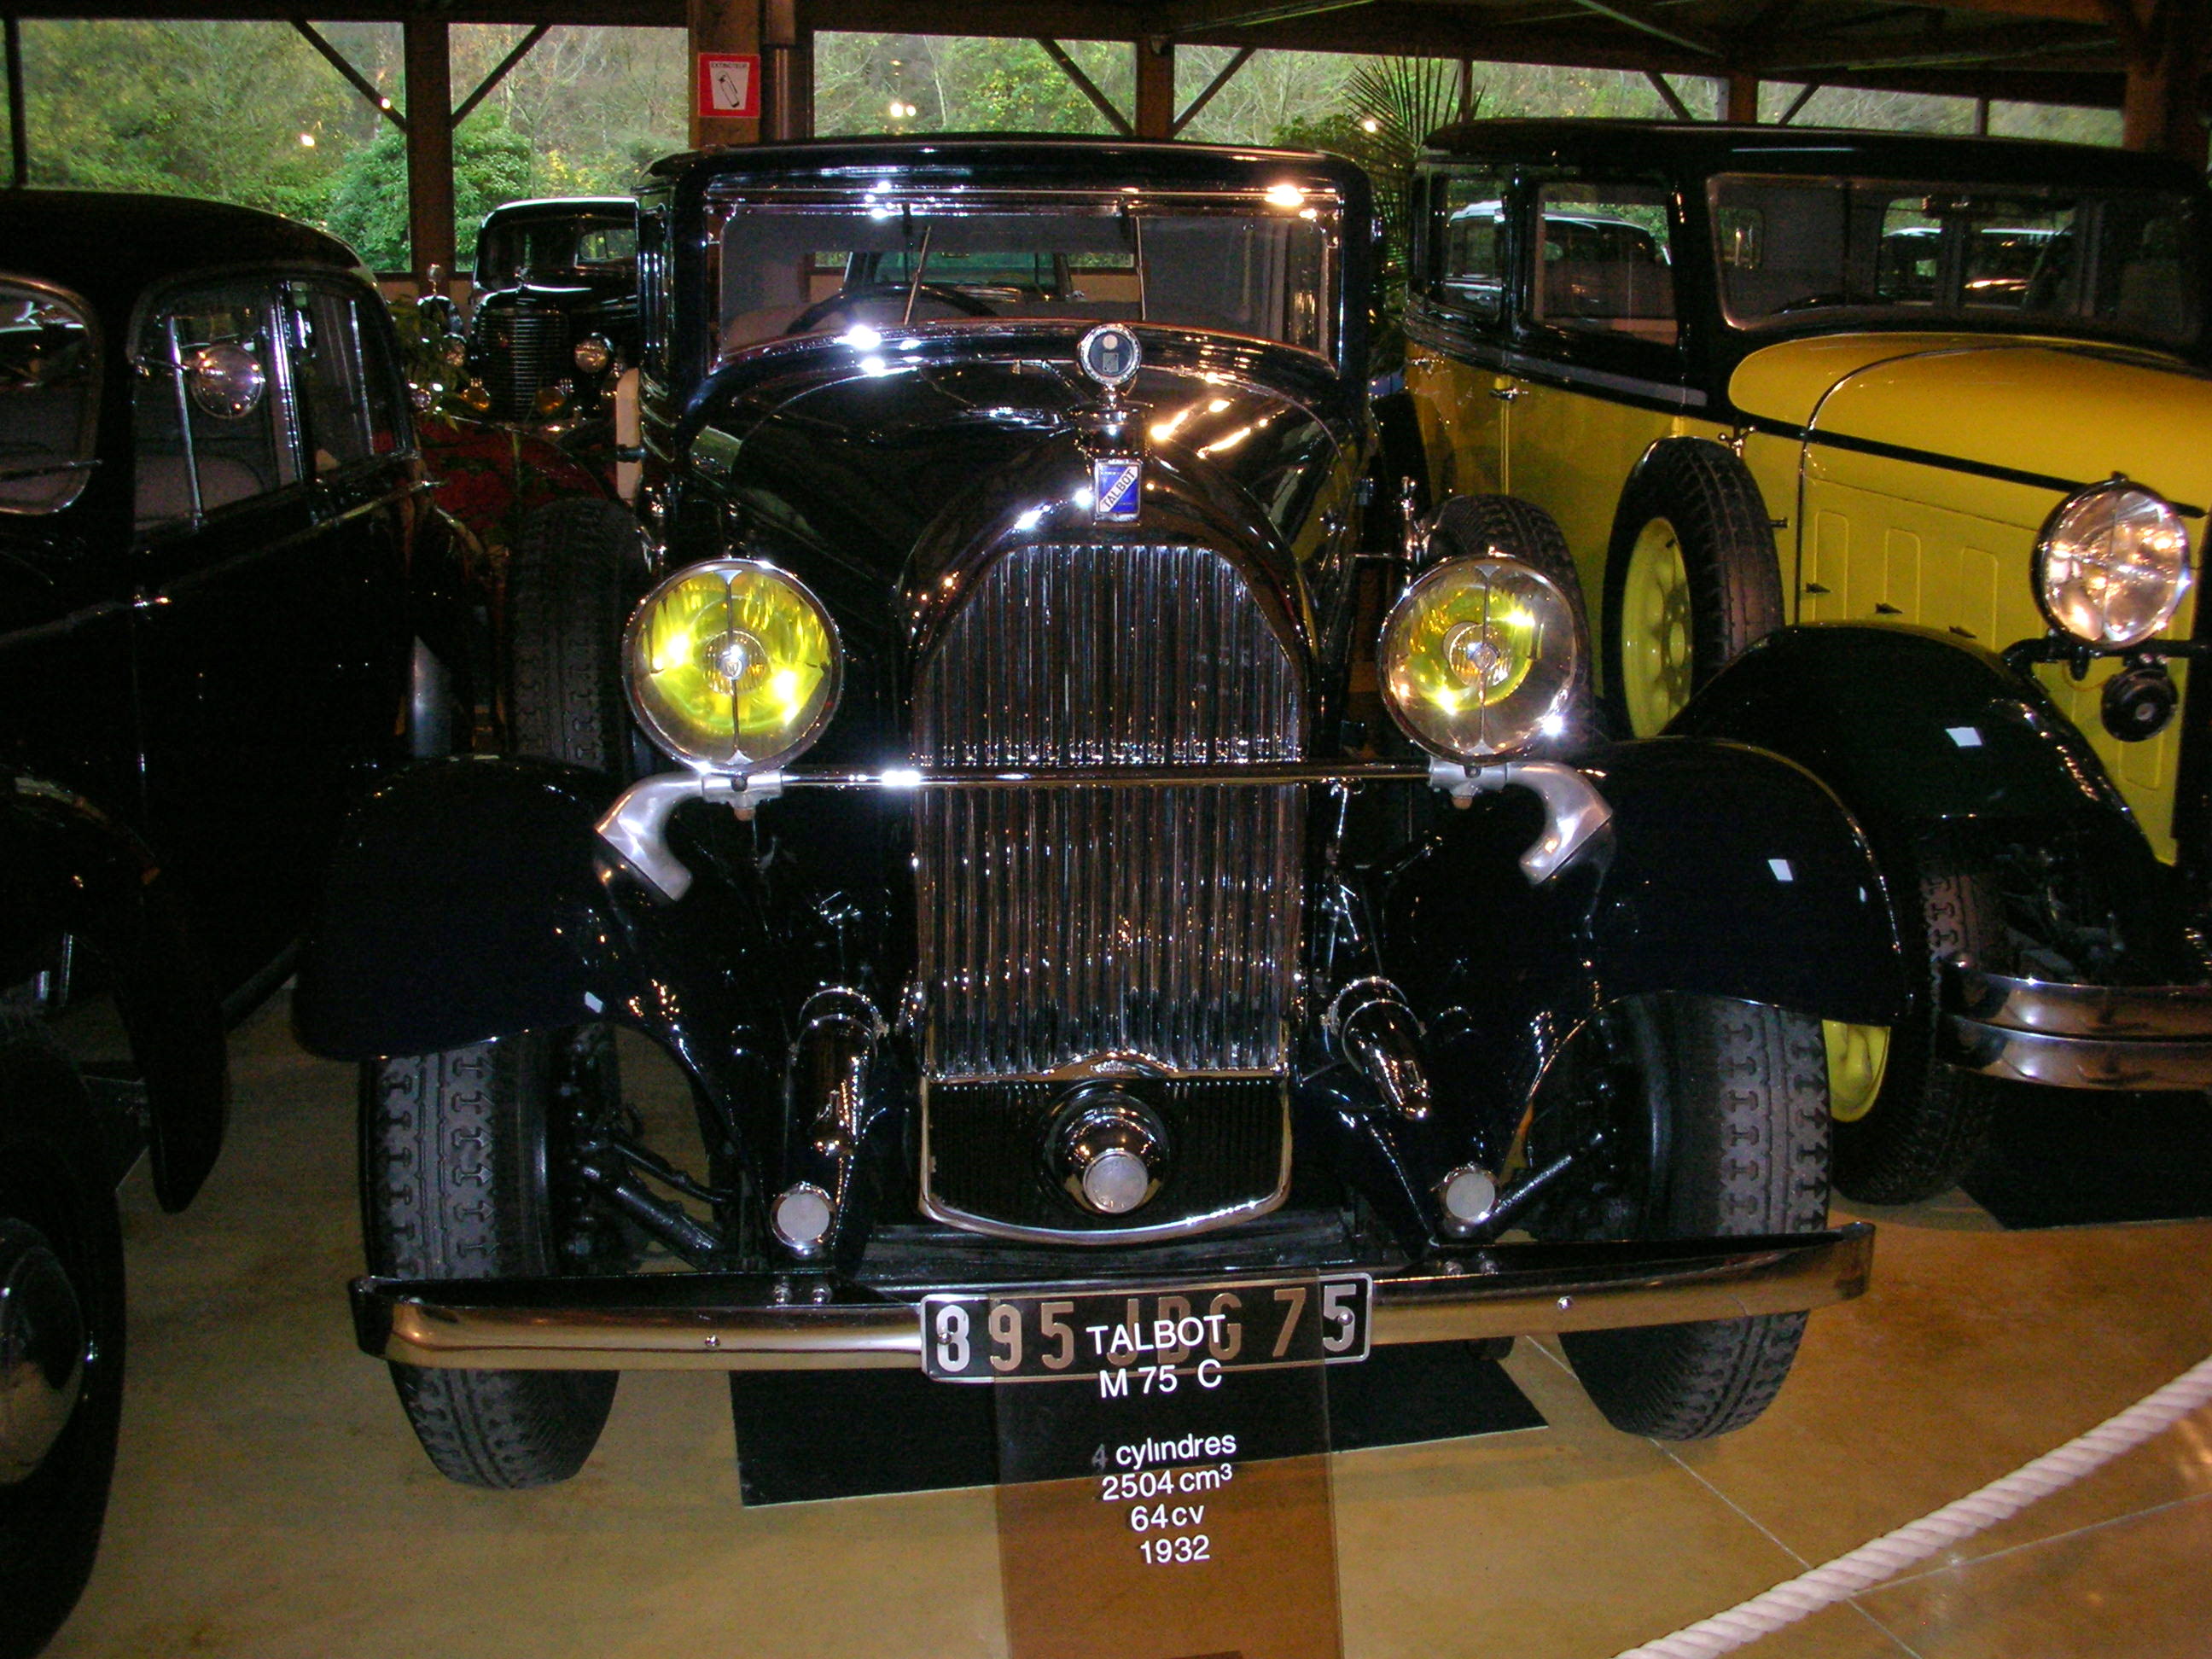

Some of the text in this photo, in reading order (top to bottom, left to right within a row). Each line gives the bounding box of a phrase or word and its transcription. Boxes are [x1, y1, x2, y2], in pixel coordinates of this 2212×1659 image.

[1102, 469, 1136, 509] TALBOT
[937, 1301, 1074, 1372] 895
[1272, 1284, 1358, 1358] 75
[1086, 1314, 1226, 1355] TALBOT
[1099, 1359, 1223, 1399] M 75 C
[1091, 1433, 1237, 1471] 4 cylindres
[1102, 1470, 1174, 1501] 2504
[1140, 1534, 1210, 1564] 1932
